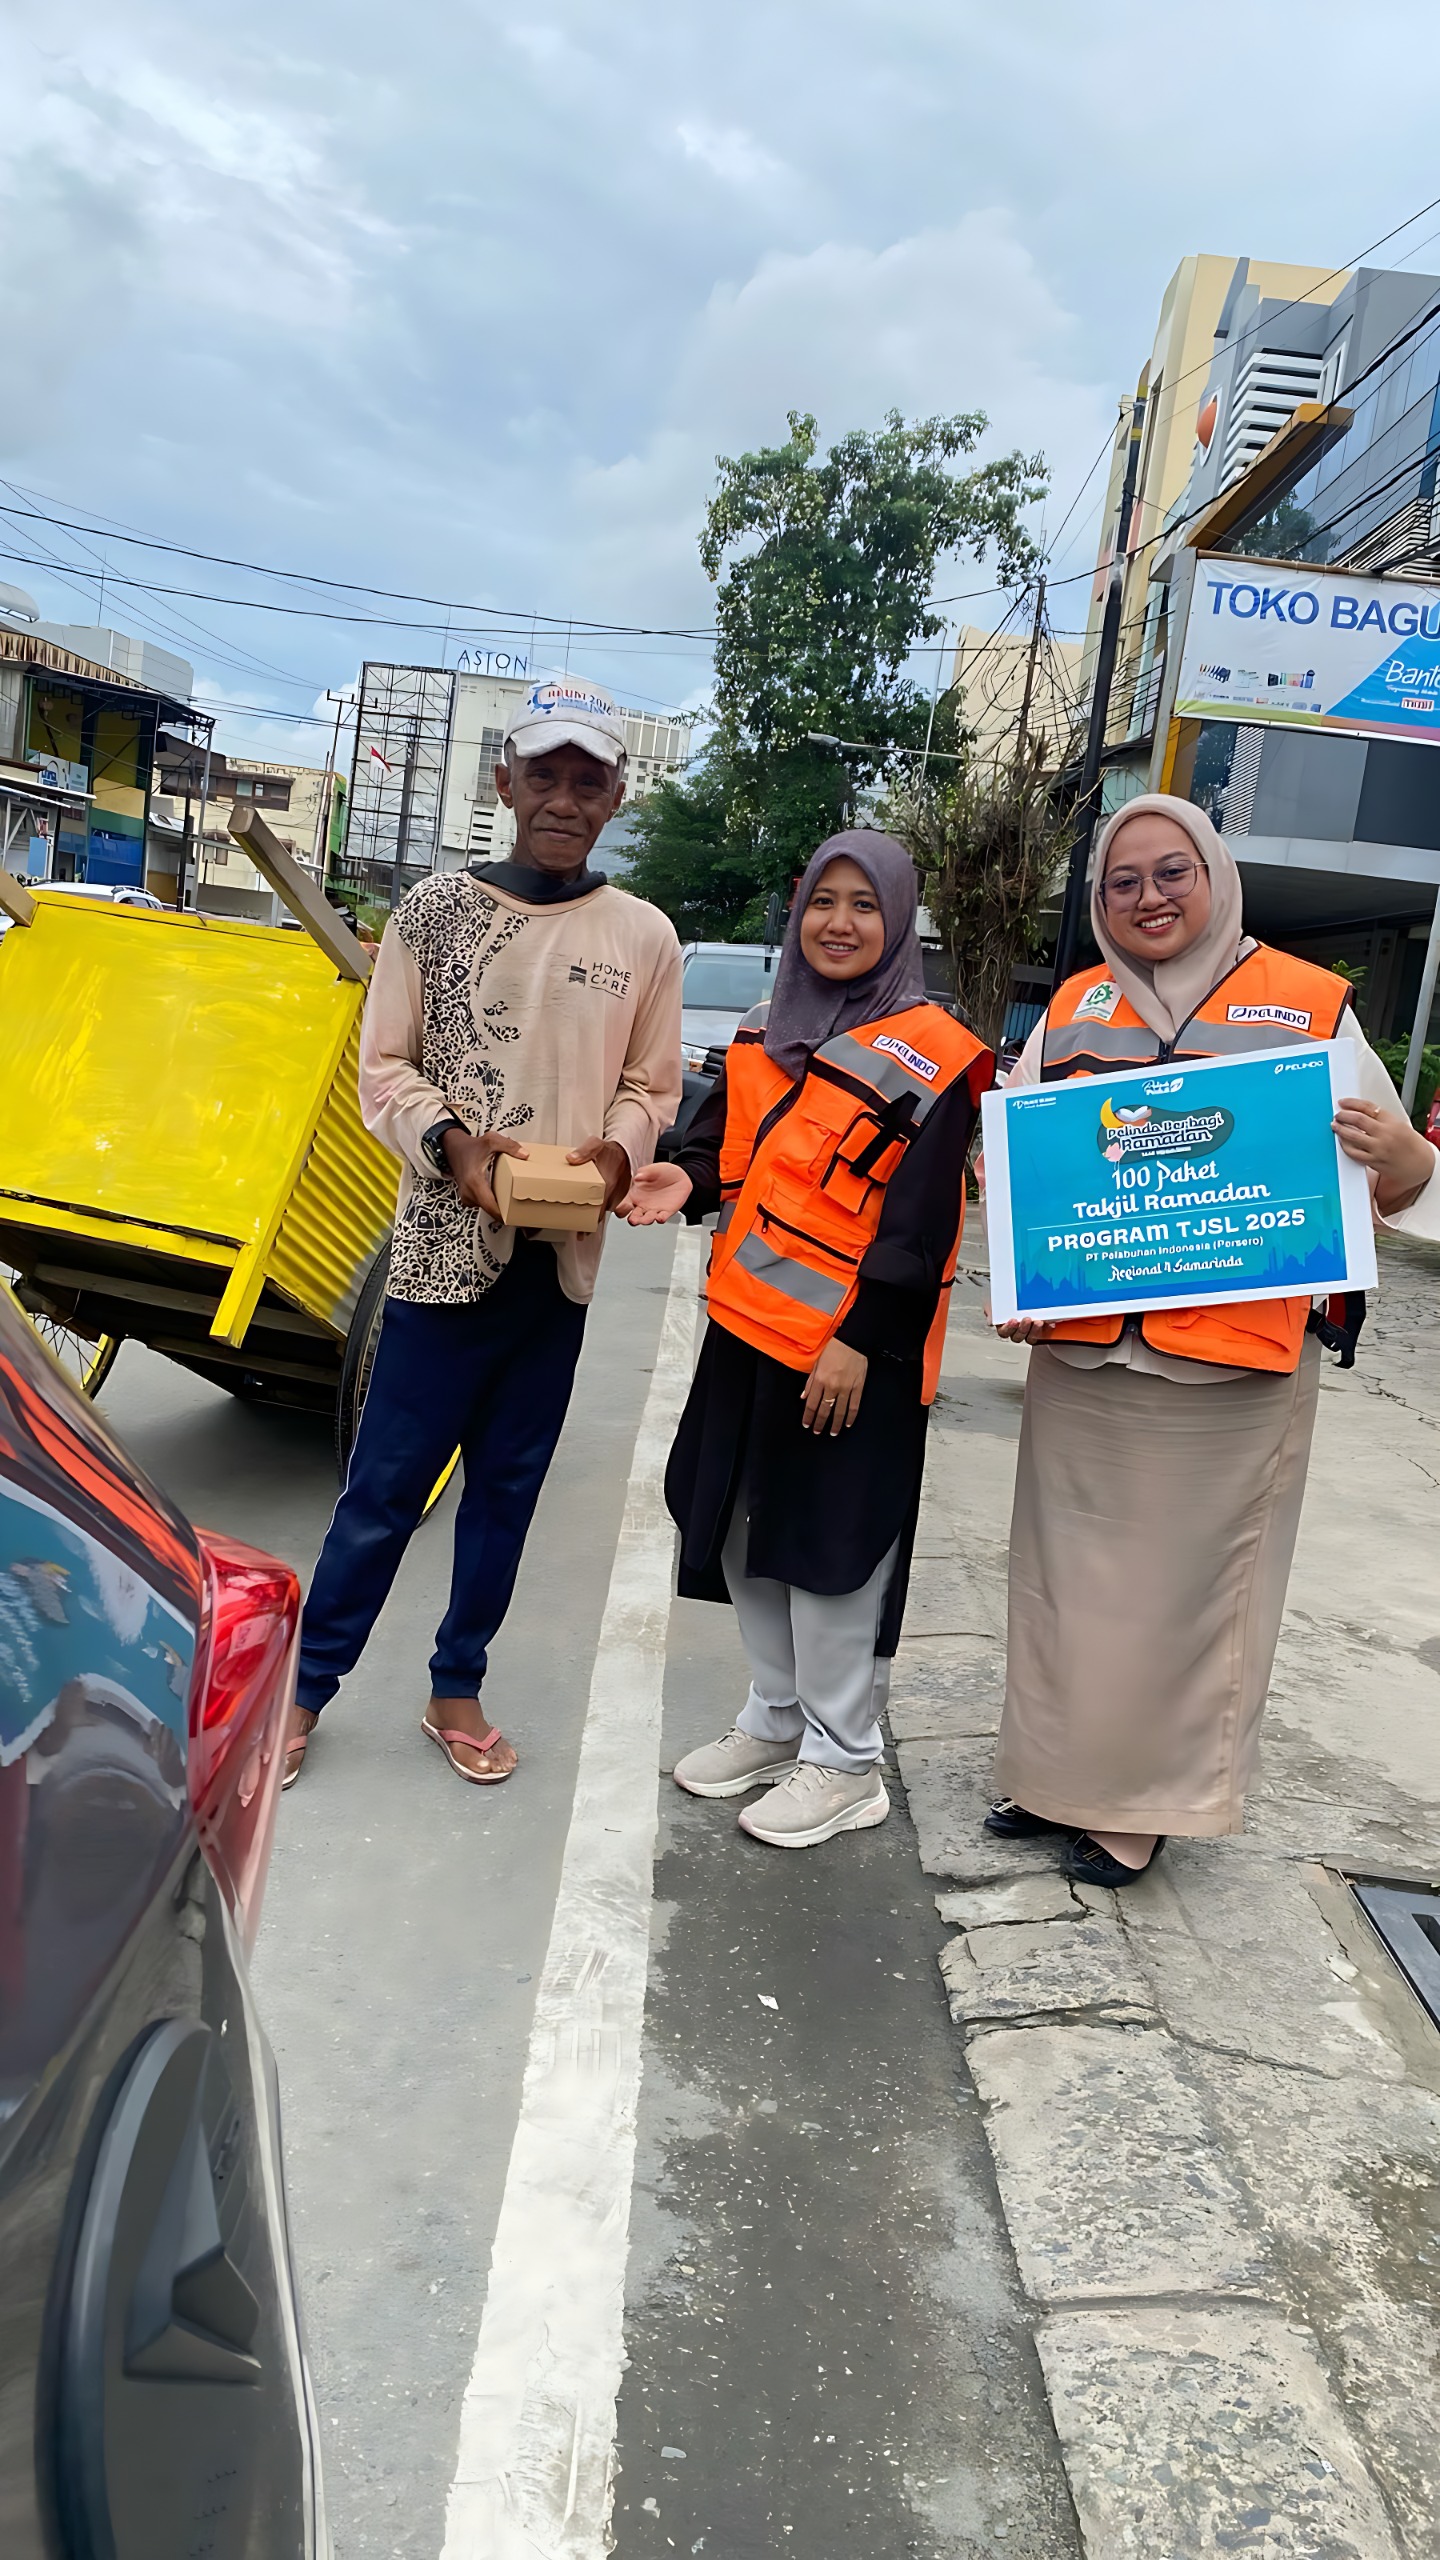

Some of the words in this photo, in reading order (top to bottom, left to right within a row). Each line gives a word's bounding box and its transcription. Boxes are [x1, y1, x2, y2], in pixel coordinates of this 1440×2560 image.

[1207, 581, 1320, 625] TOKO
[457, 649, 528, 675] ASTON
[590, 974, 628, 996] CARE
[592, 962, 632, 983] HOME
[1248, 1008, 1307, 1025] PELINDO
[889, 1039, 935, 1076] PELINDO
[1107, 1122, 1160, 1139] Pelindo
[1162, 1111, 1224, 1132] Berbagi
[1120, 1130, 1213, 1151] Ramadan
[1112, 1165, 1151, 1190] 100
[1155, 1160, 1220, 1192] Paket
[1072, 1193, 1140, 1219] Takjil
[1144, 1182, 1272, 1211] Ramadan
[1047, 1223, 1169, 1252] PROGRAM
[1175, 1216, 1240, 1238] TJSL
[1245, 1208, 1306, 1231] 2025
[1086, 1252, 1099, 1262] PT
[1101, 1245, 1157, 1261] Pelabuhan
[1158, 1243, 1210, 1255] Indonesia
[1213, 1236, 1264, 1250] (Persero)
[1107, 1262, 1162, 1282] Regional
[1173, 1255, 1244, 1273] Samarinda
